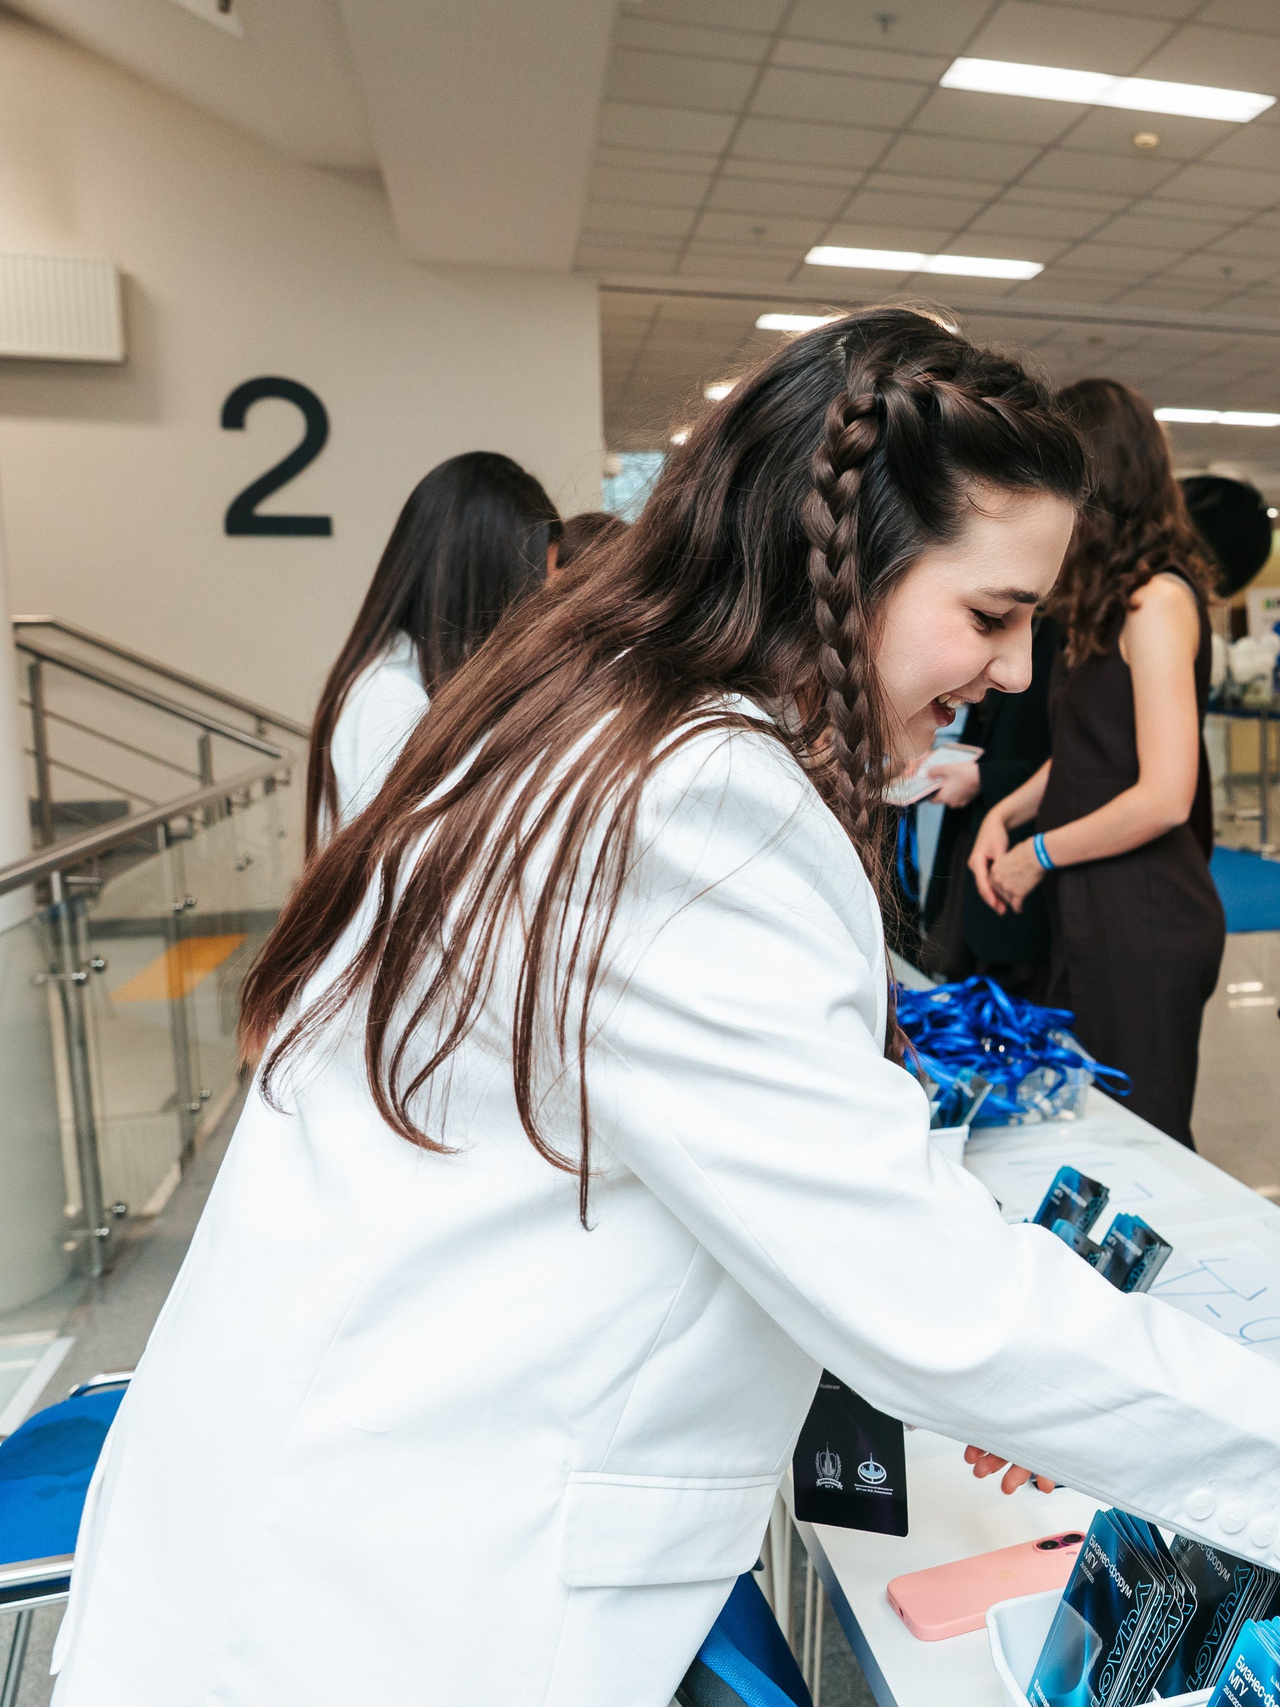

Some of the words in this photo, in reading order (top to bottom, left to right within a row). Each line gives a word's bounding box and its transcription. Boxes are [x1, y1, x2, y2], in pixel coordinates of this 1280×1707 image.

[221, 376, 332, 536] 2
[1083, 1547, 1098, 1569] МГУ
[1088, 1534, 1133, 1599] Бизнес-форум
[1228, 1670, 1249, 1697] МГУ
